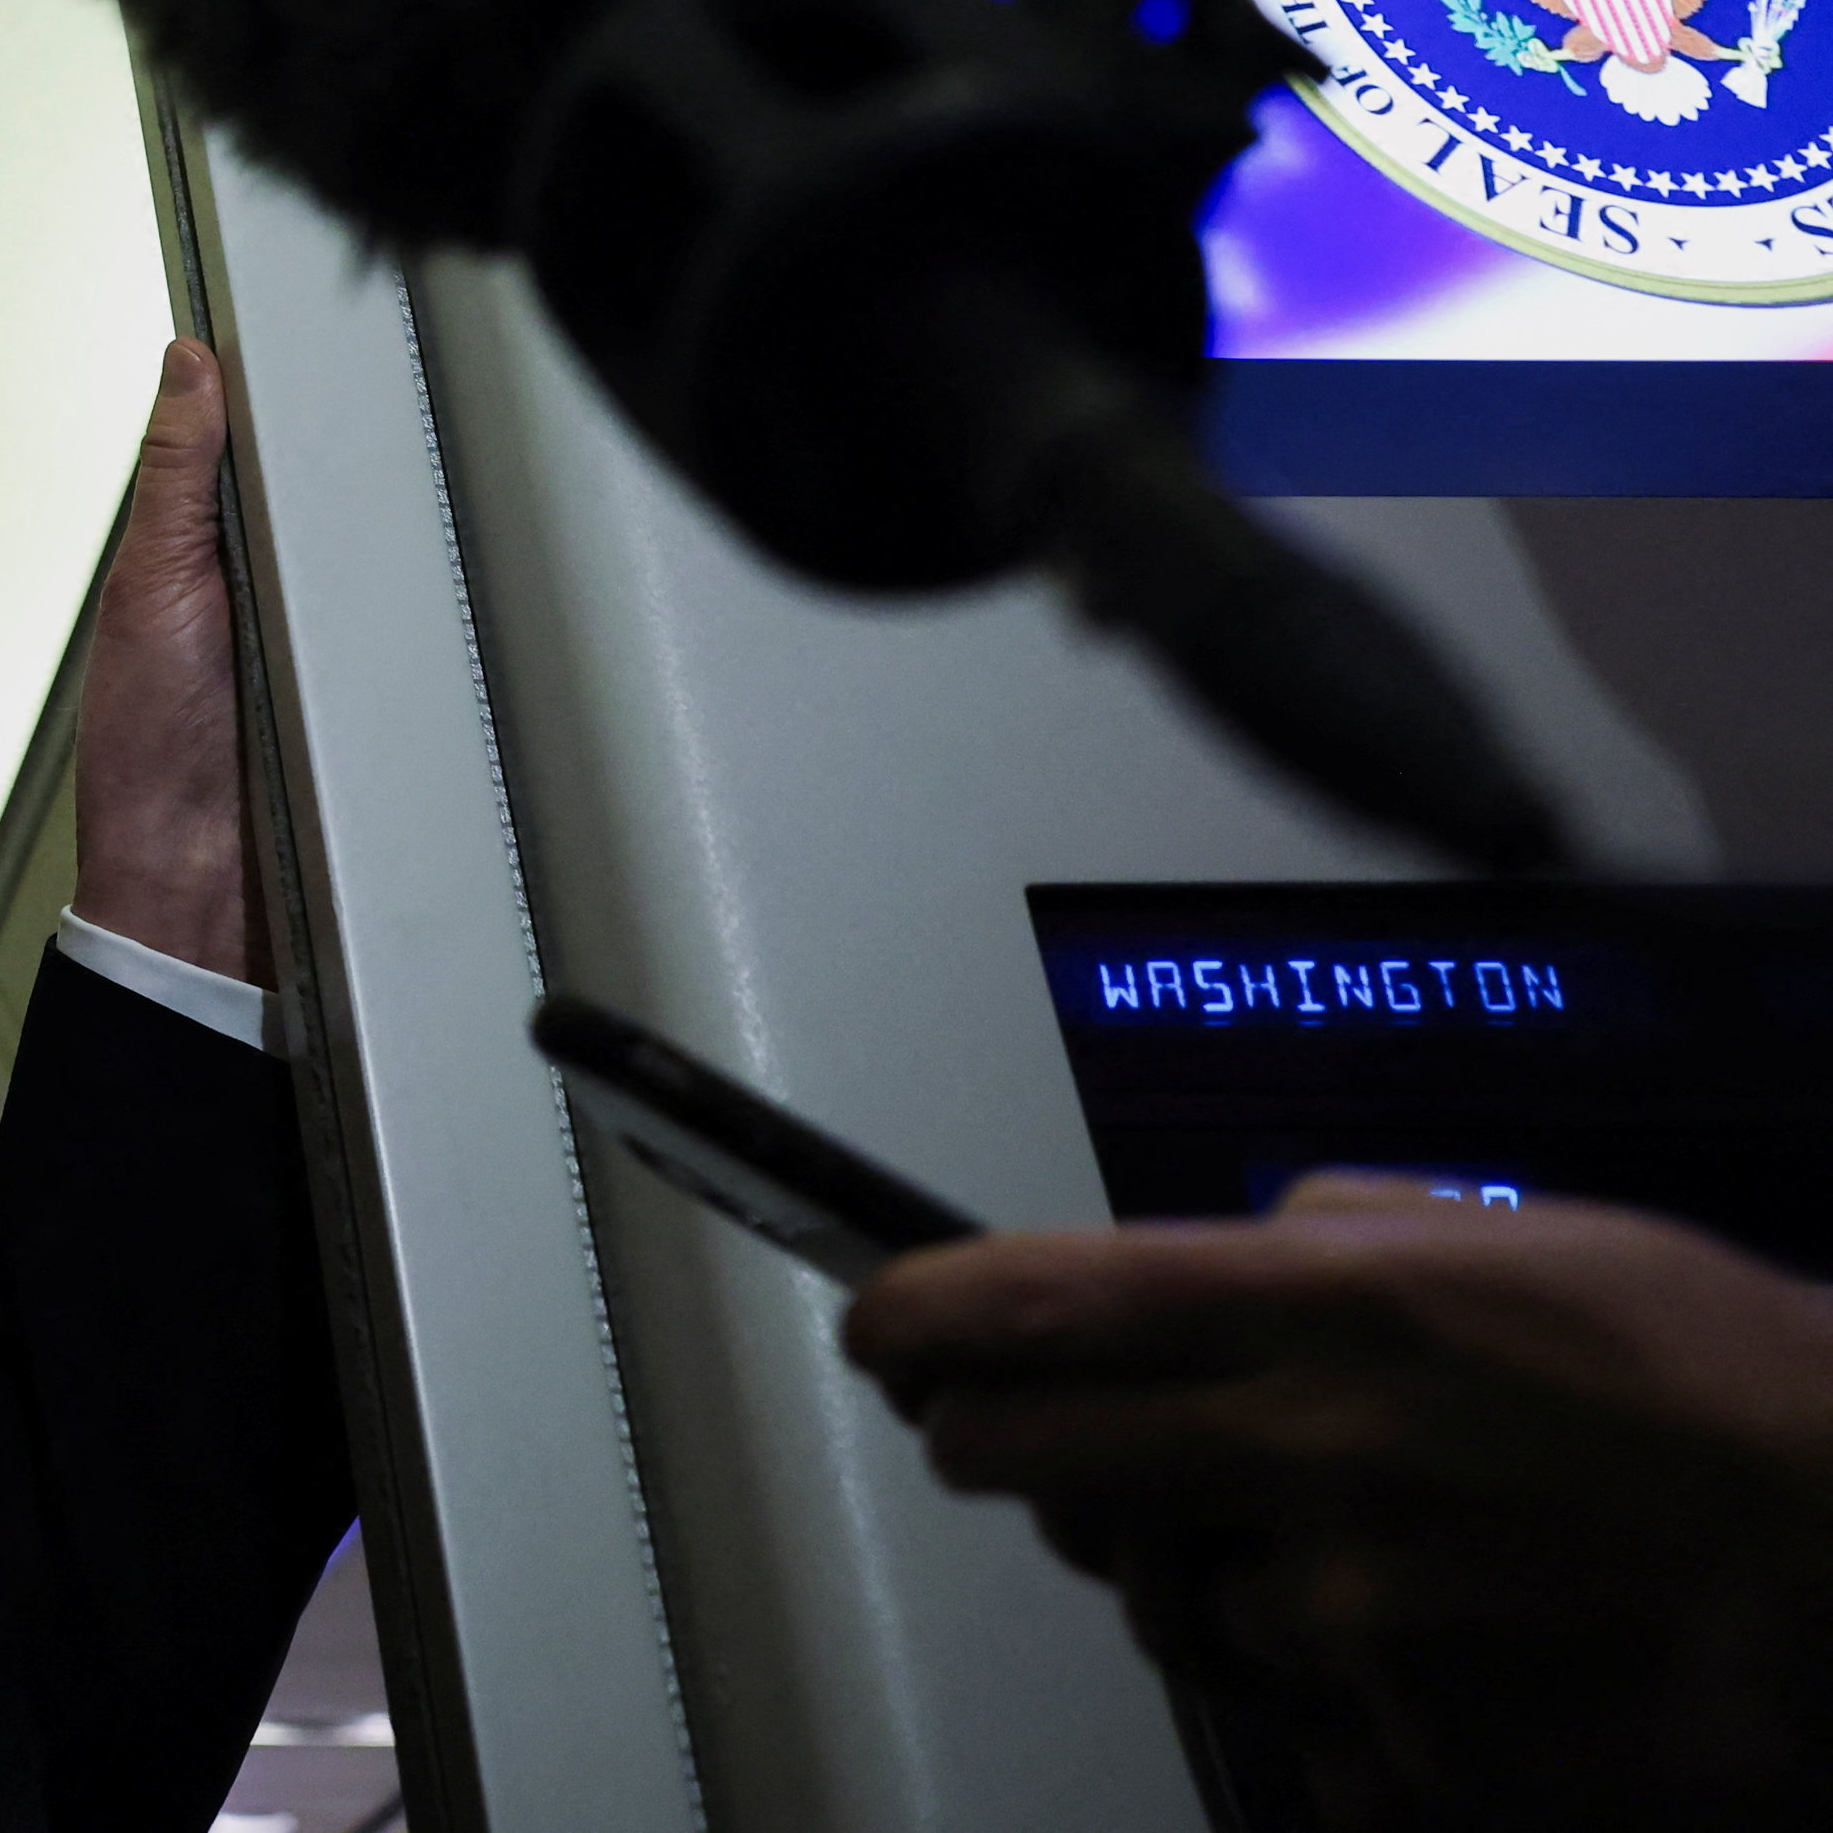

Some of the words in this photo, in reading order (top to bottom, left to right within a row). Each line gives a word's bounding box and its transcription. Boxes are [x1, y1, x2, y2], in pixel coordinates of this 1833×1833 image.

[1330, 66, 1394, 116] OF
[1417, 117, 1640, 255] SEAL
[1098, 960, 1565, 1013] WASHINGTON
